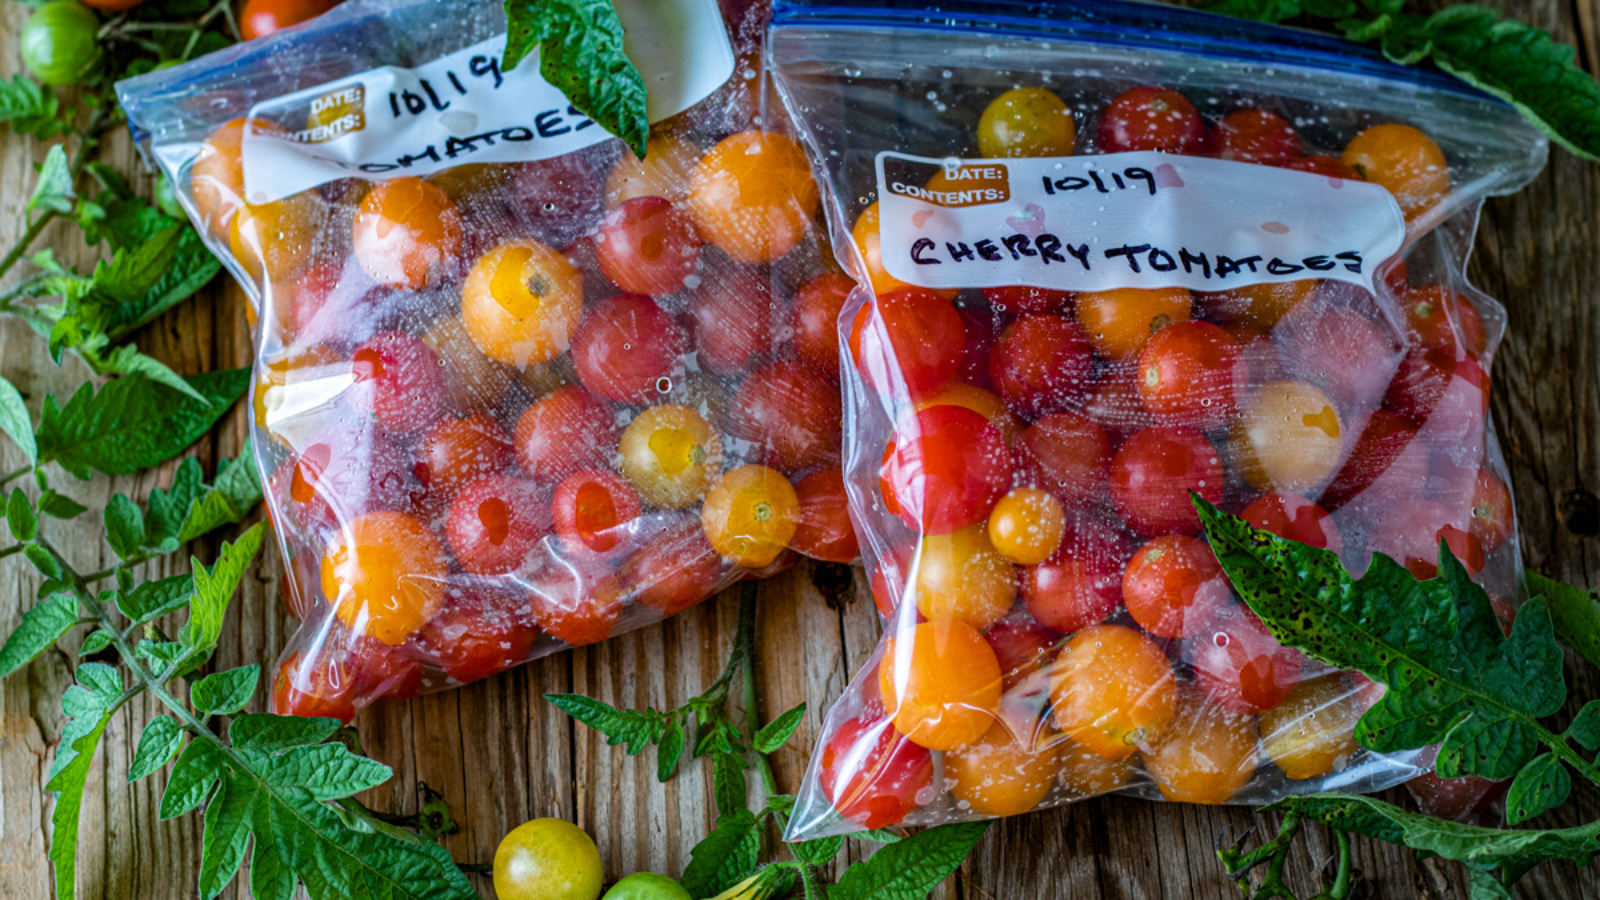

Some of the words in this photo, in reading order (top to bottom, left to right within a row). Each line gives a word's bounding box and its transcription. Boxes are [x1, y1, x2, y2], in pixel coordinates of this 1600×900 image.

[311, 88, 361, 116] DATE:
[258, 114, 361, 143] NTENTS:
[945, 167, 1002, 180] DATE:
[892, 181, 1004, 204] CONTENTS:
[911, 233, 1091, 271] CHERRY
[1105, 243, 1363, 278] TOMATOES
